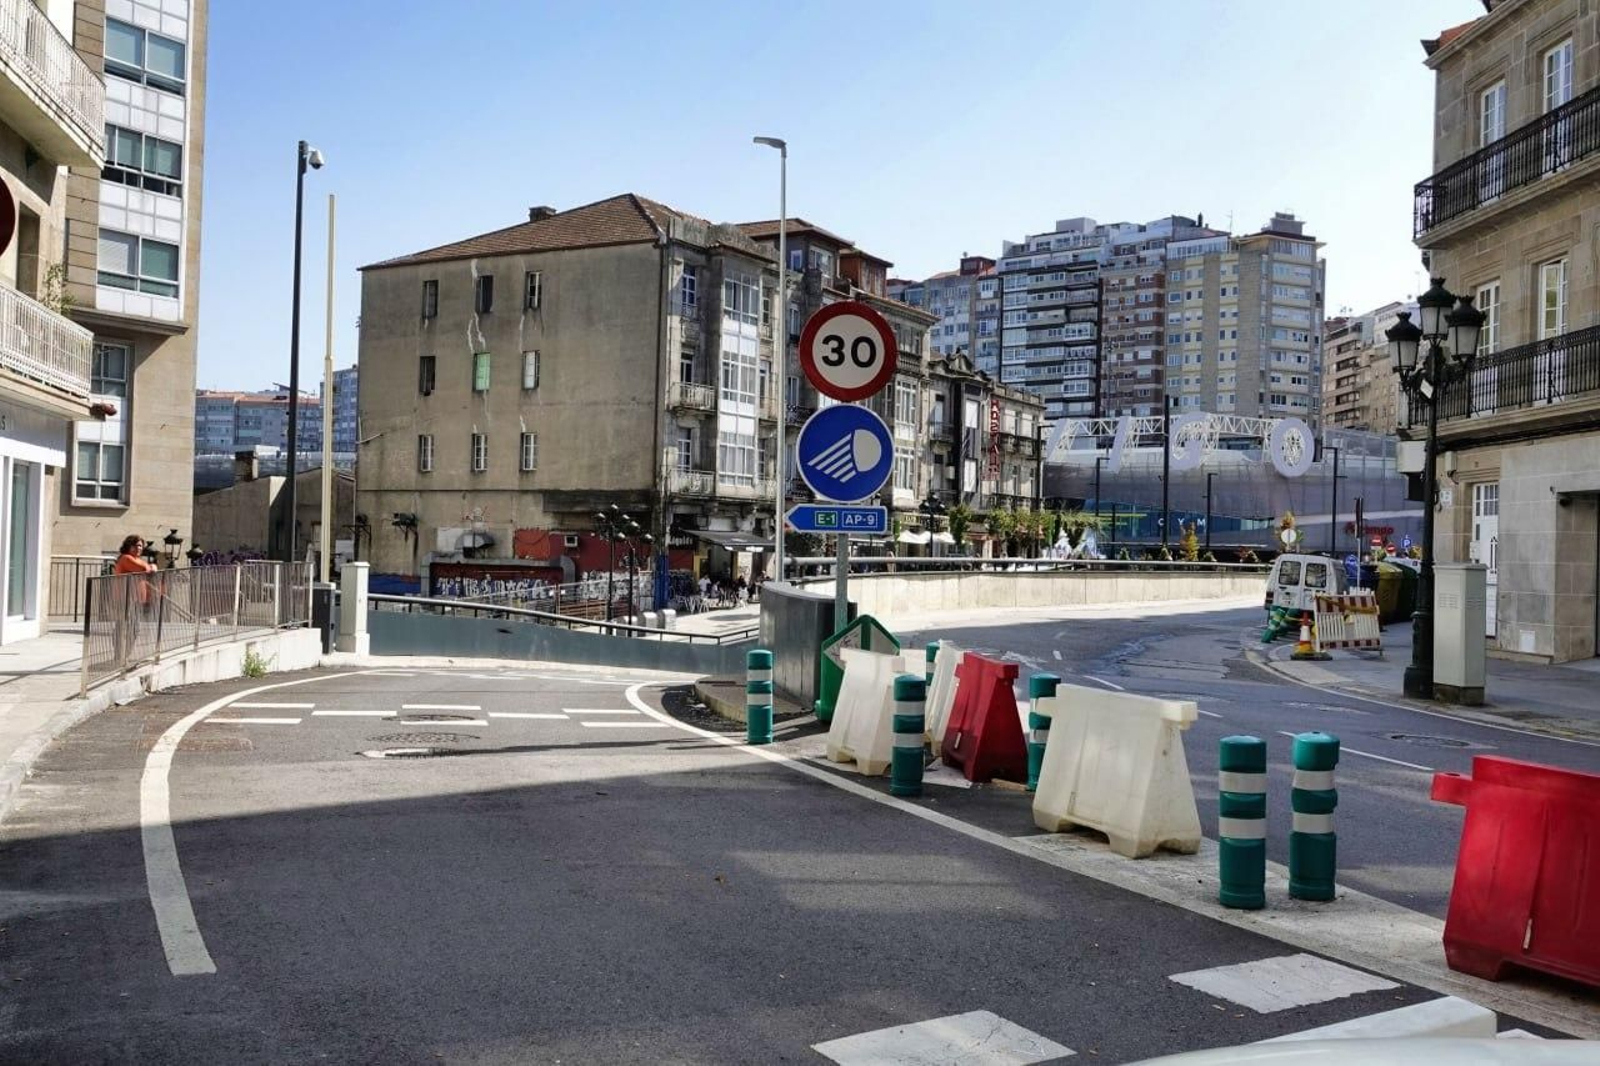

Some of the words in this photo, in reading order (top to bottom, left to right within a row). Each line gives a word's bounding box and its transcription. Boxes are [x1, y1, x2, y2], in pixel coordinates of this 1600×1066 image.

[821, 334, 877, 368] 30
[818, 513, 836, 524] E-1
[845, 514, 875, 525] AP-9
